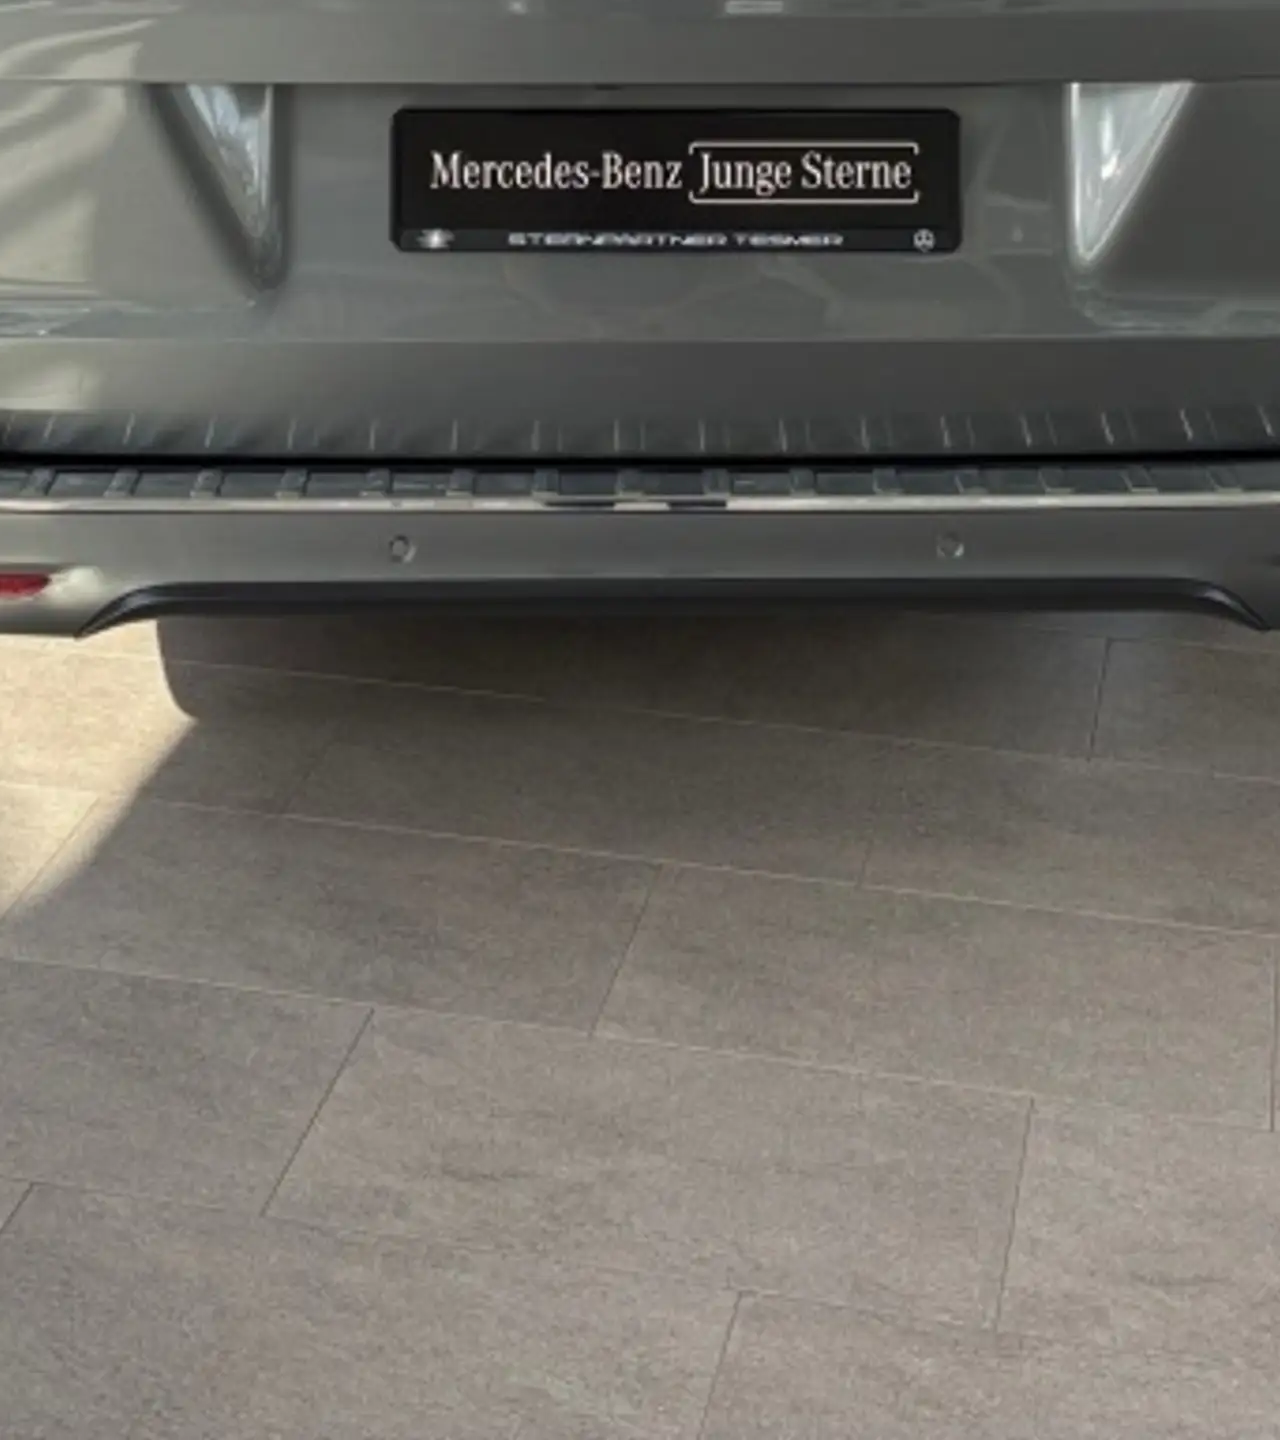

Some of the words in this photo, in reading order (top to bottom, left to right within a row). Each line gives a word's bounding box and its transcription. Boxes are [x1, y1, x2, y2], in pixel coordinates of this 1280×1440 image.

[429, 150, 684, 191] Mercedes-Benz
[697, 152, 792, 196] Junge
[800, 150, 913, 191] Sterne
